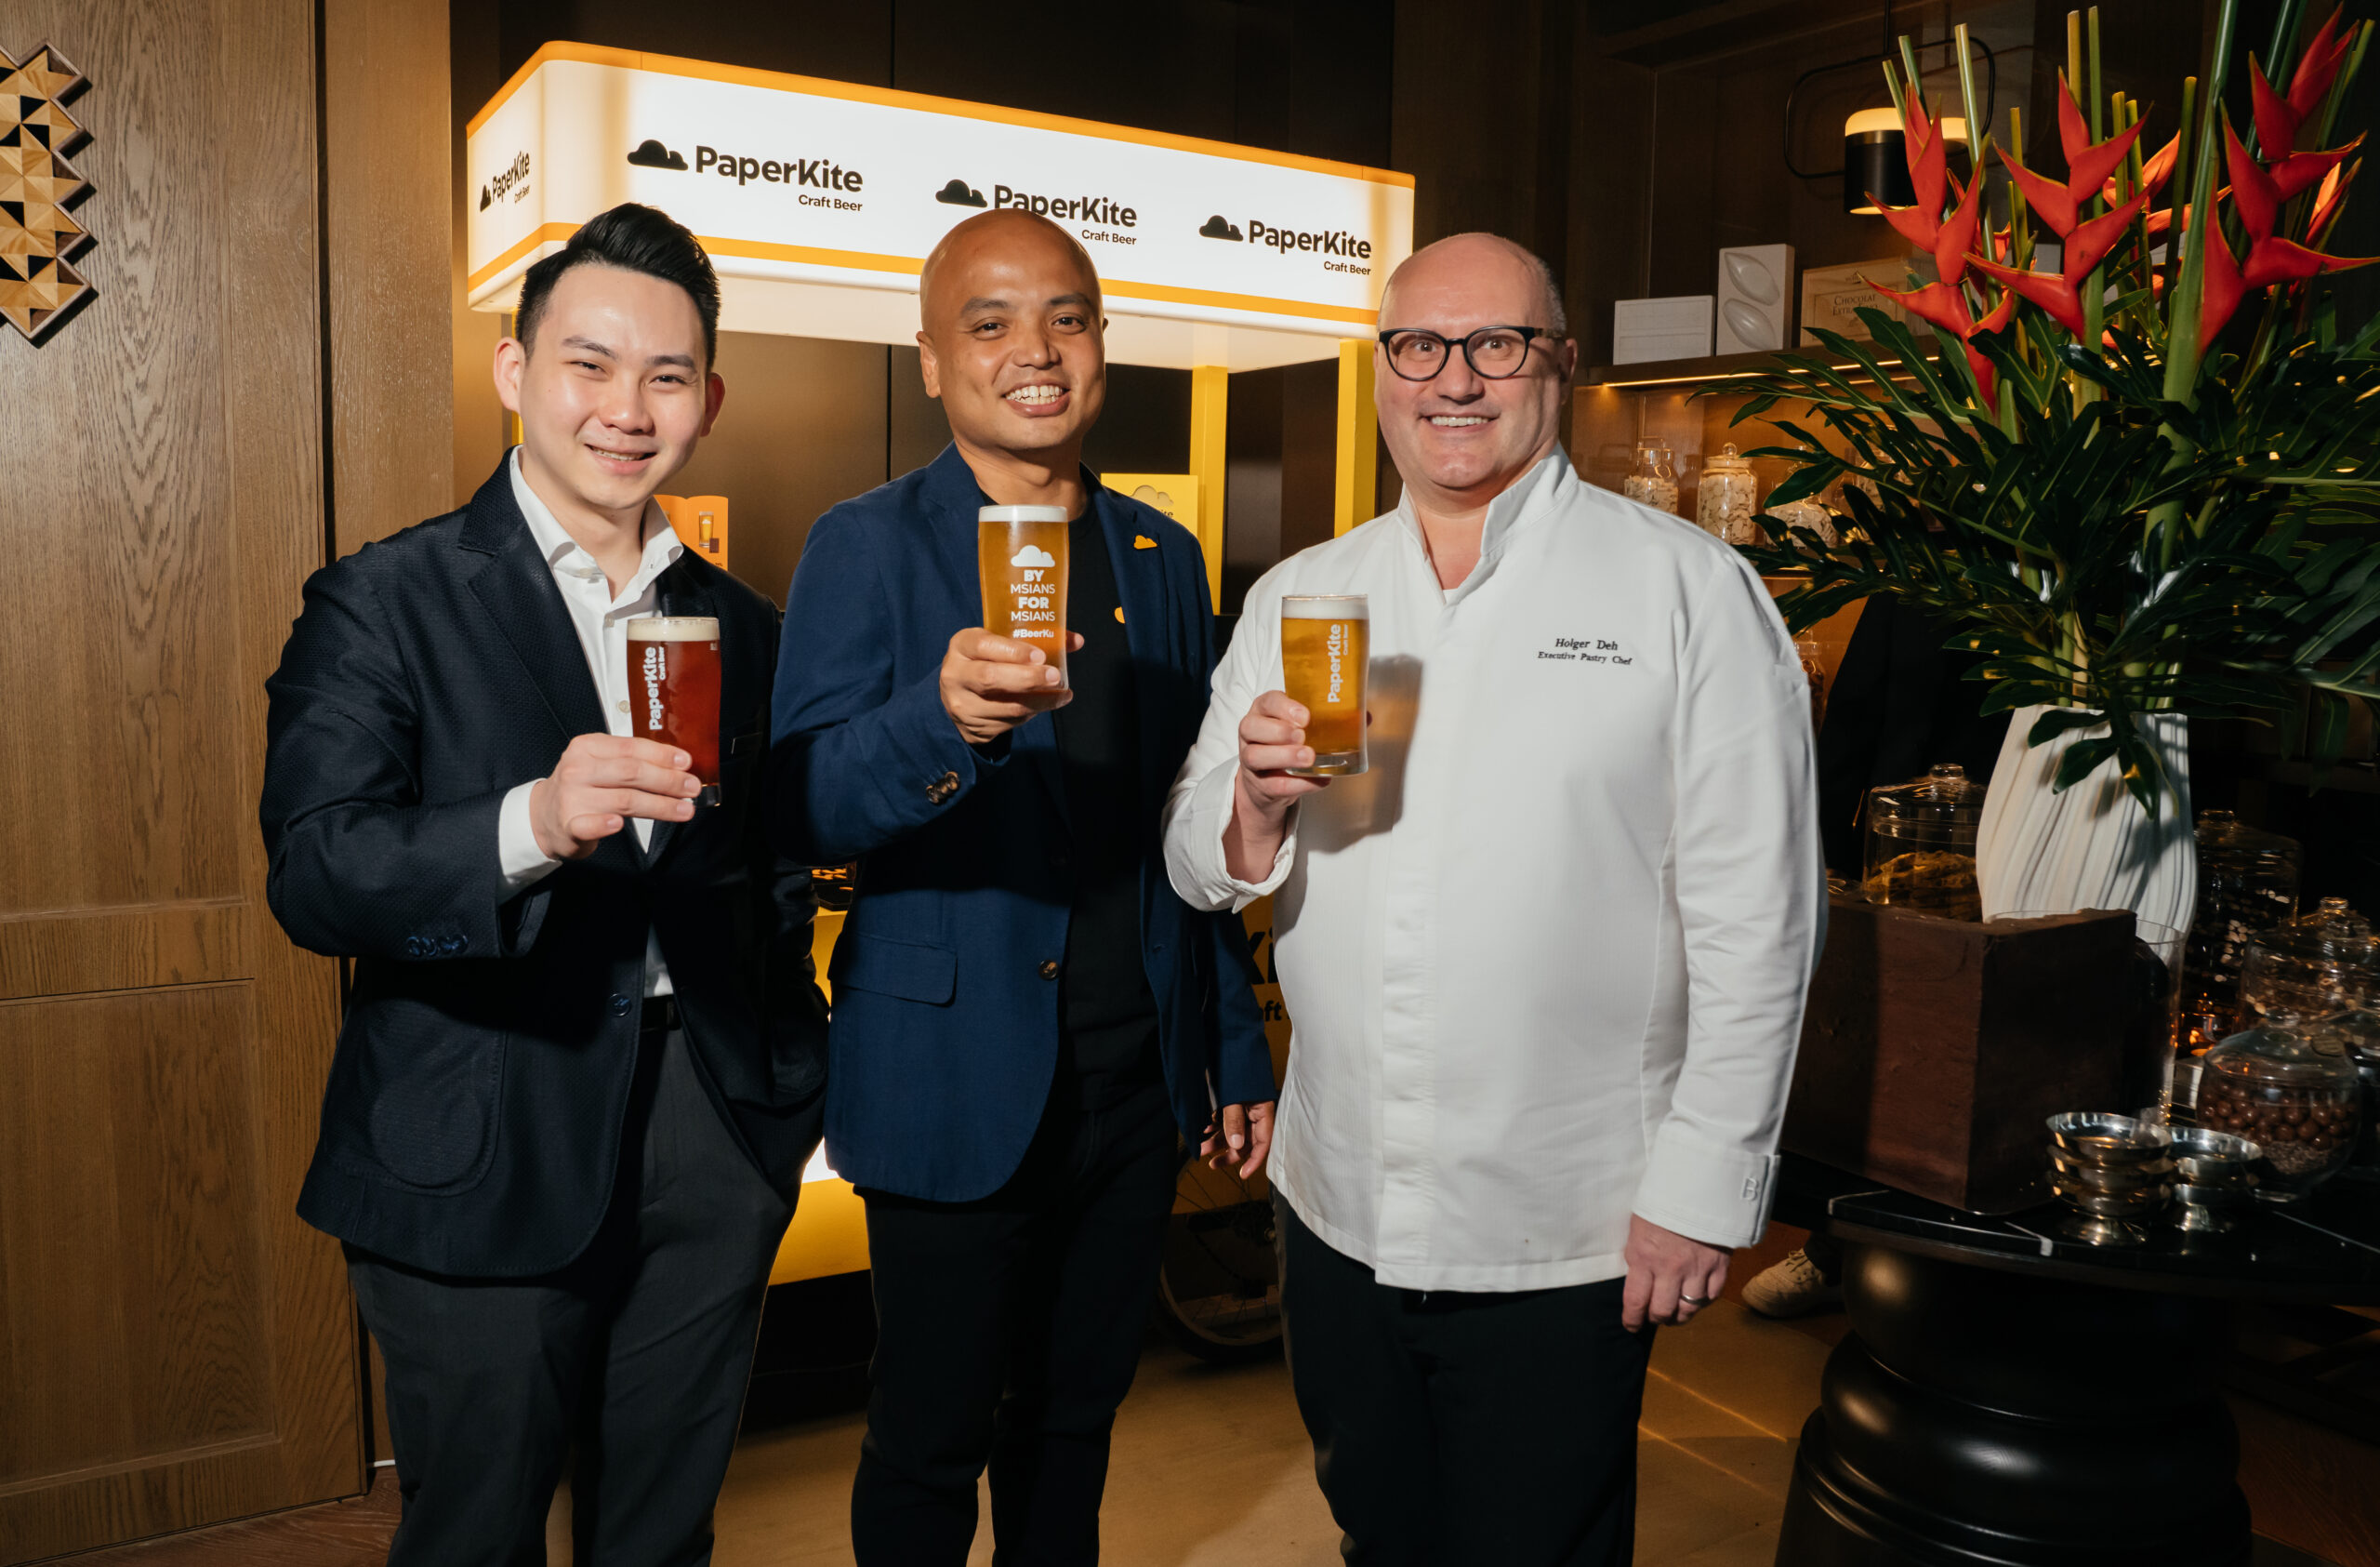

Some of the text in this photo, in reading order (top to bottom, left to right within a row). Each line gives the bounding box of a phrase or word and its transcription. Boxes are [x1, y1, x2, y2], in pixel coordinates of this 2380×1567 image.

[493, 151, 530, 203] PaperKite
[696, 145, 863, 193] PaperKite
[799, 194, 863, 212] Craft Beer
[995, 184, 1137, 227] PaperKite
[1081, 229, 1137, 246] Craft Beer
[1250, 219, 1371, 259] PaperKite
[1324, 260, 1371, 275] Craft Beer
[1024, 569, 1044, 582] BY
[1011, 583, 1055, 594] MSIANS
[1018, 596, 1049, 609] FOR
[1011, 610, 1055, 622] MSIANS
[1012, 629, 1054, 639] #BeerKu
[1555, 638, 1618, 651] Holger Deh
[1327, 624, 1342, 702] PaperKite
[1538, 651, 1633, 666] Executive Pastry Chef
[643, 646, 664, 730] PaperKite
